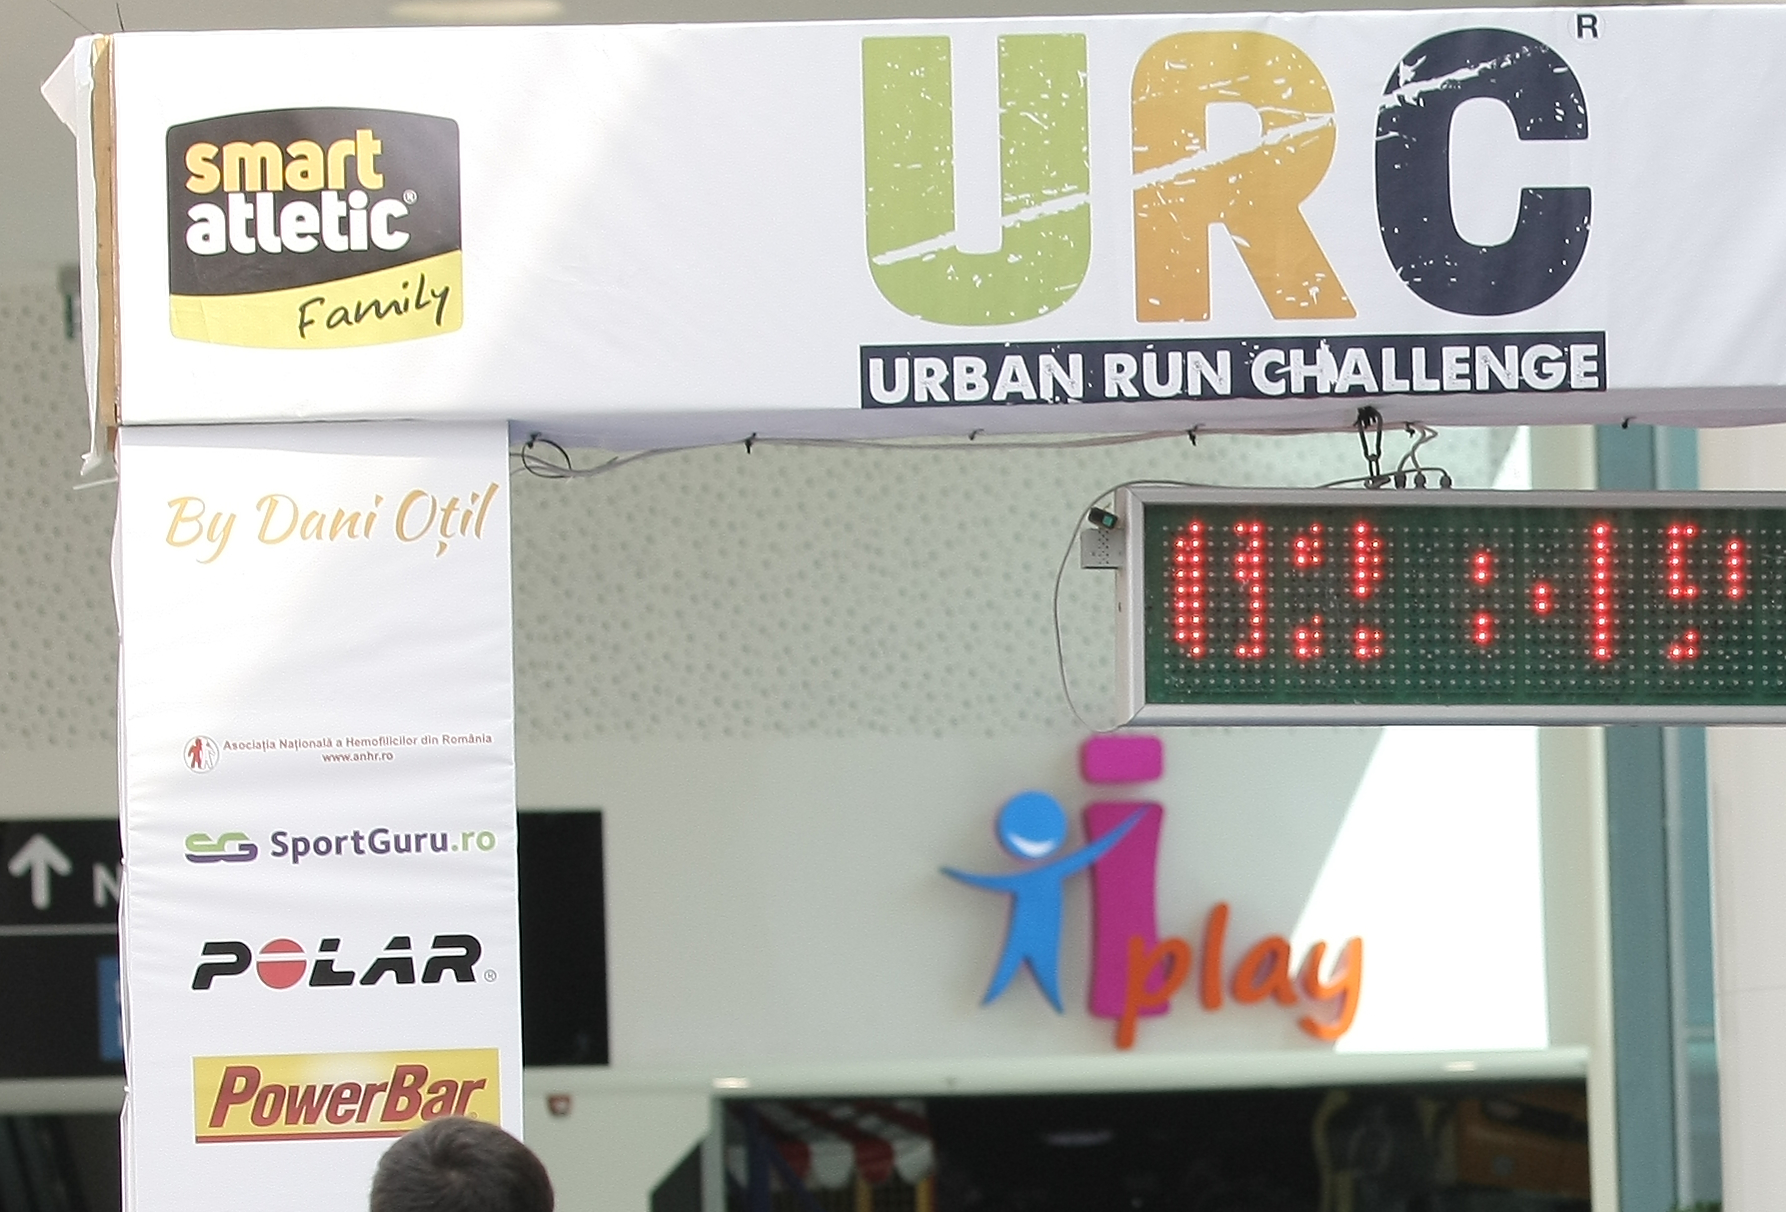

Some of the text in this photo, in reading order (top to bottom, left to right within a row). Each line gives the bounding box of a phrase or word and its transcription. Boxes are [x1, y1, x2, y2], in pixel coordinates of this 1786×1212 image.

[184, 129, 383, 194] smart
[861, 27, 1593, 327] URC
[185, 190, 411, 256] atletic
[296, 274, 450, 341] Family
[868, 342, 1601, 405] URBAN RUN CHALLENGE
[164, 496, 236, 565] By
[254, 493, 383, 547] Dani
[321, 751, 394, 763] www.anhr.ro
[421, 734, 439, 746] din
[442, 732, 492, 744] România
[270, 828, 497, 864] SportGuru.ro
[191, 933, 483, 991] POLAR
[208, 1063, 488, 1129] PowerBar
